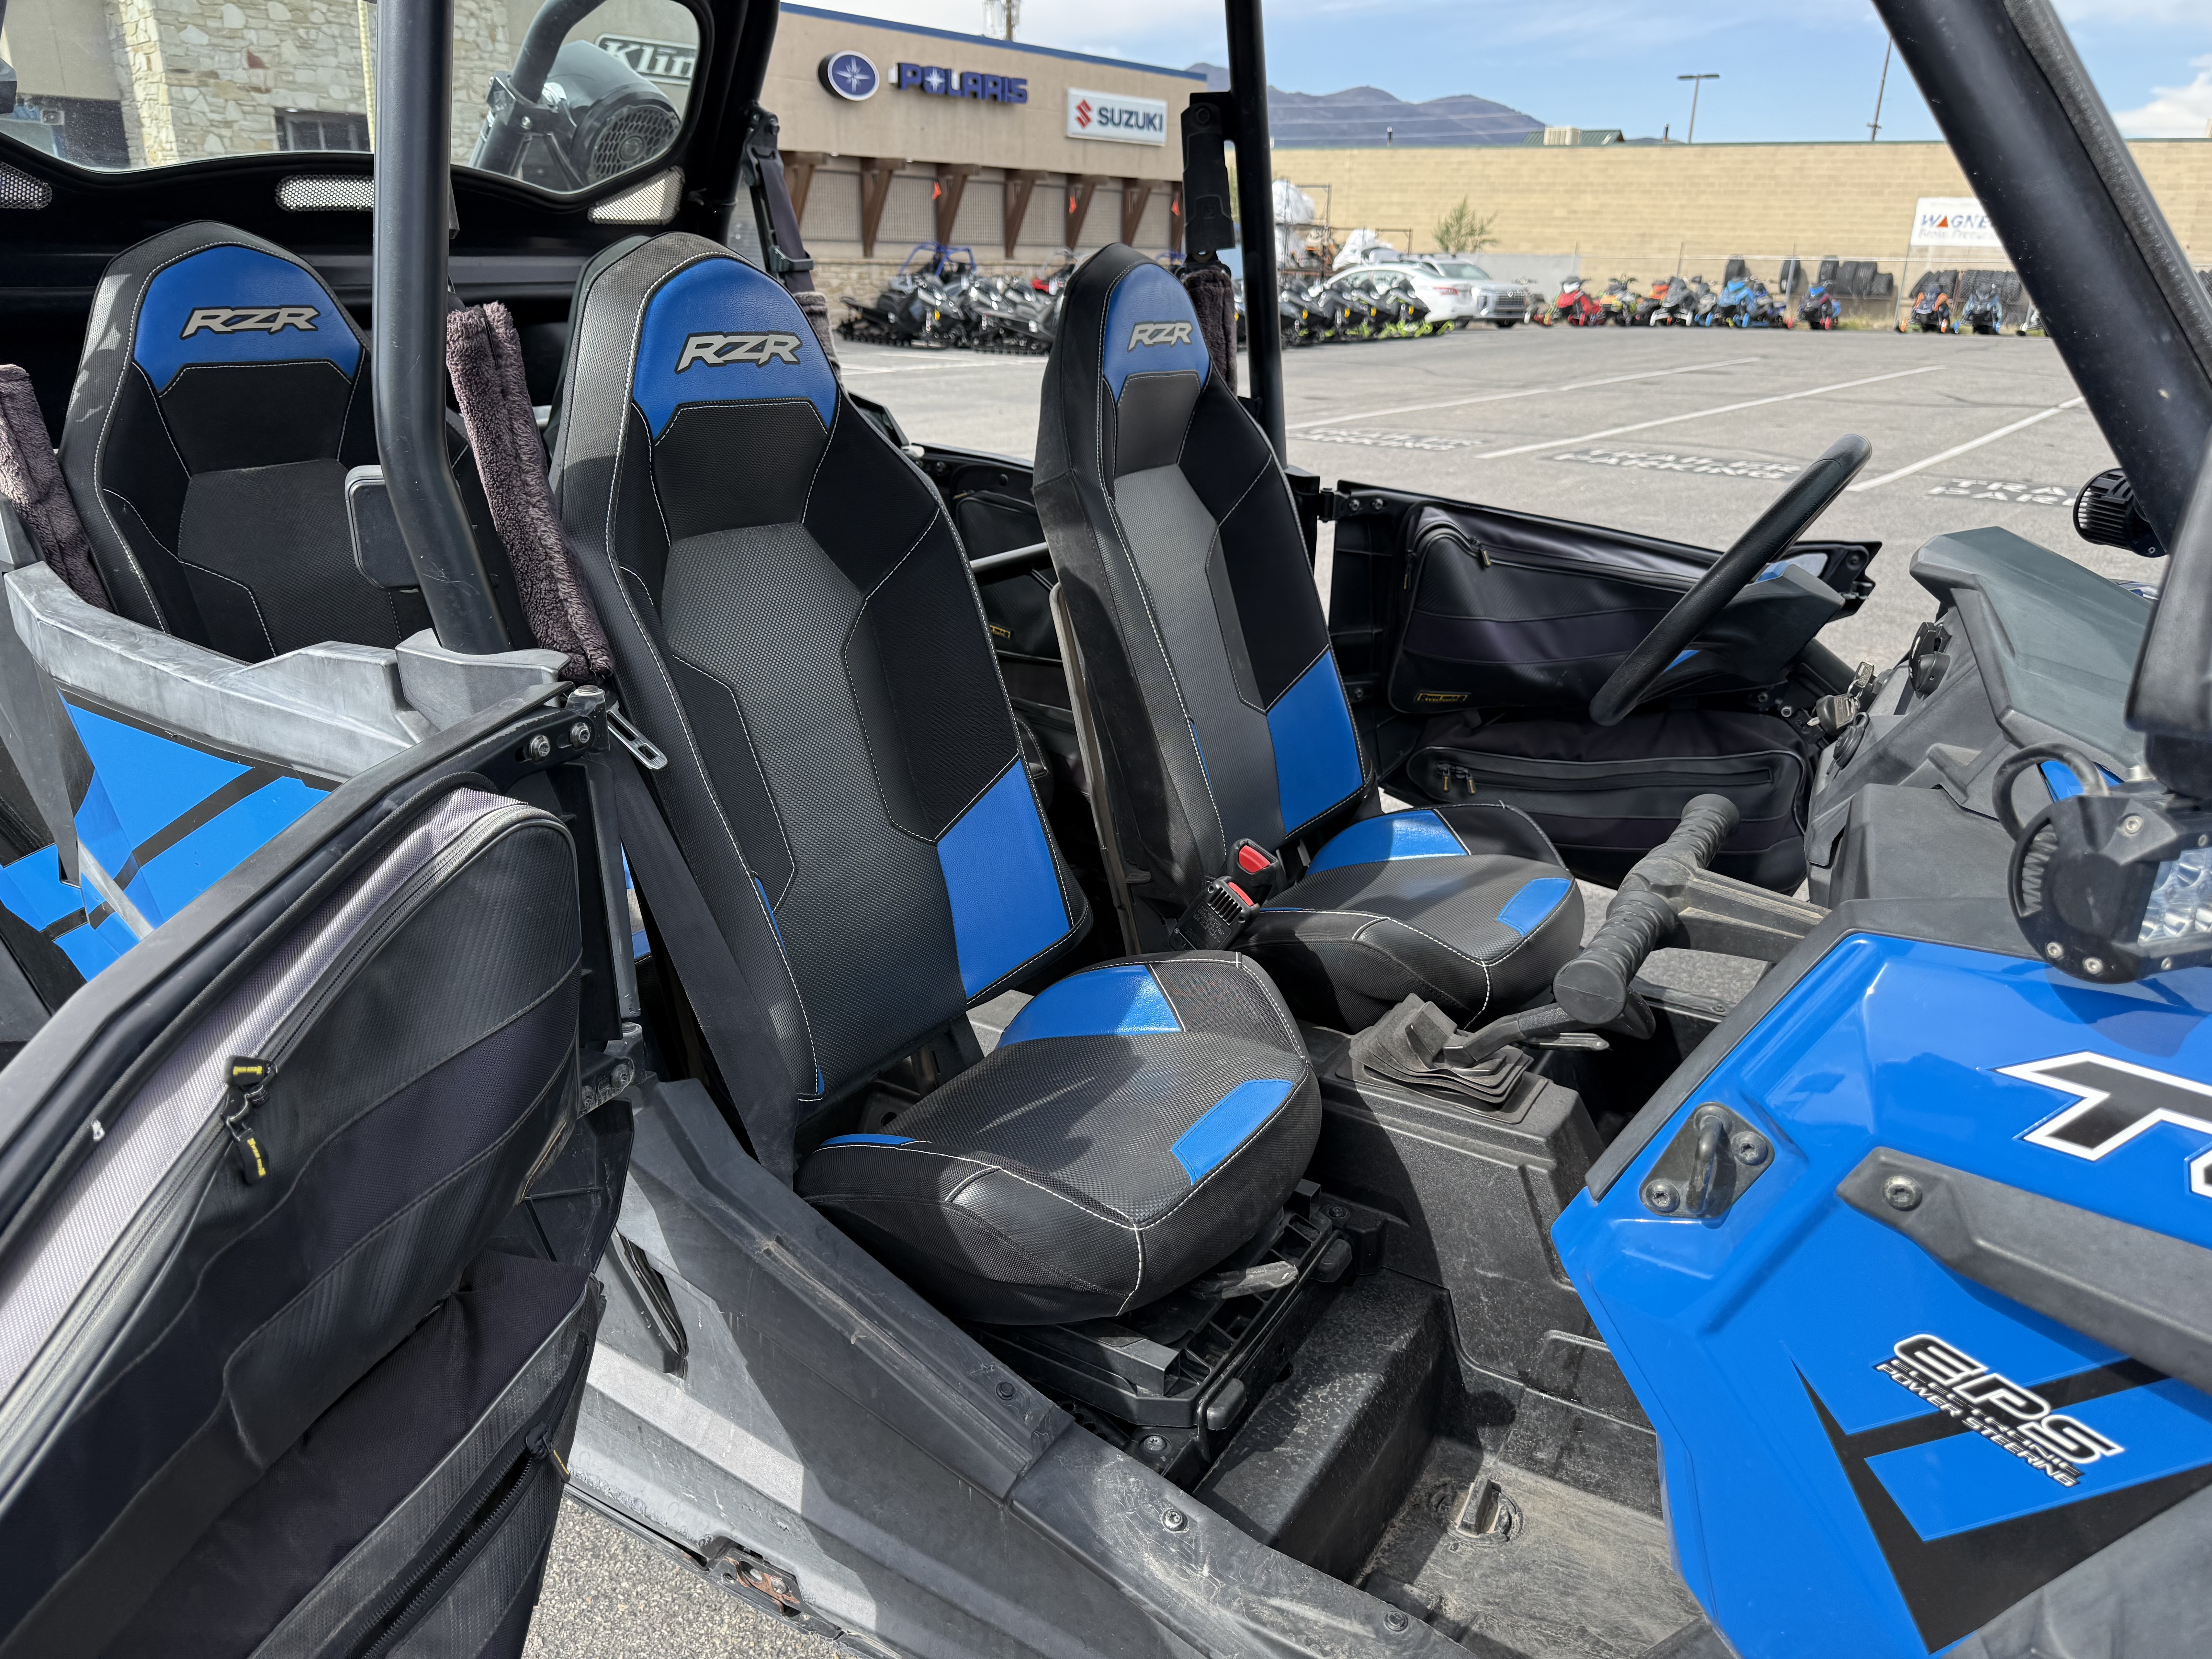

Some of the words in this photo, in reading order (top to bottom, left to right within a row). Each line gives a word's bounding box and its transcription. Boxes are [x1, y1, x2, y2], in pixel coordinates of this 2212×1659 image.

[897, 62, 1027, 104] POLARIS
[1097, 106, 1163, 132] SUZUKI
[1921, 214, 1990, 228] WAGNE
[180, 306, 321, 340] RZR
[1127, 320, 1192, 352] RZR
[675, 331, 803, 374] RZR
[1891, 1359, 2080, 1475] ELECTRONIC
[1894, 1334, 2125, 1464] EPS
[1876, 1364, 1963, 1418] POWER
[1961, 1417, 2076, 1488] STEERING
